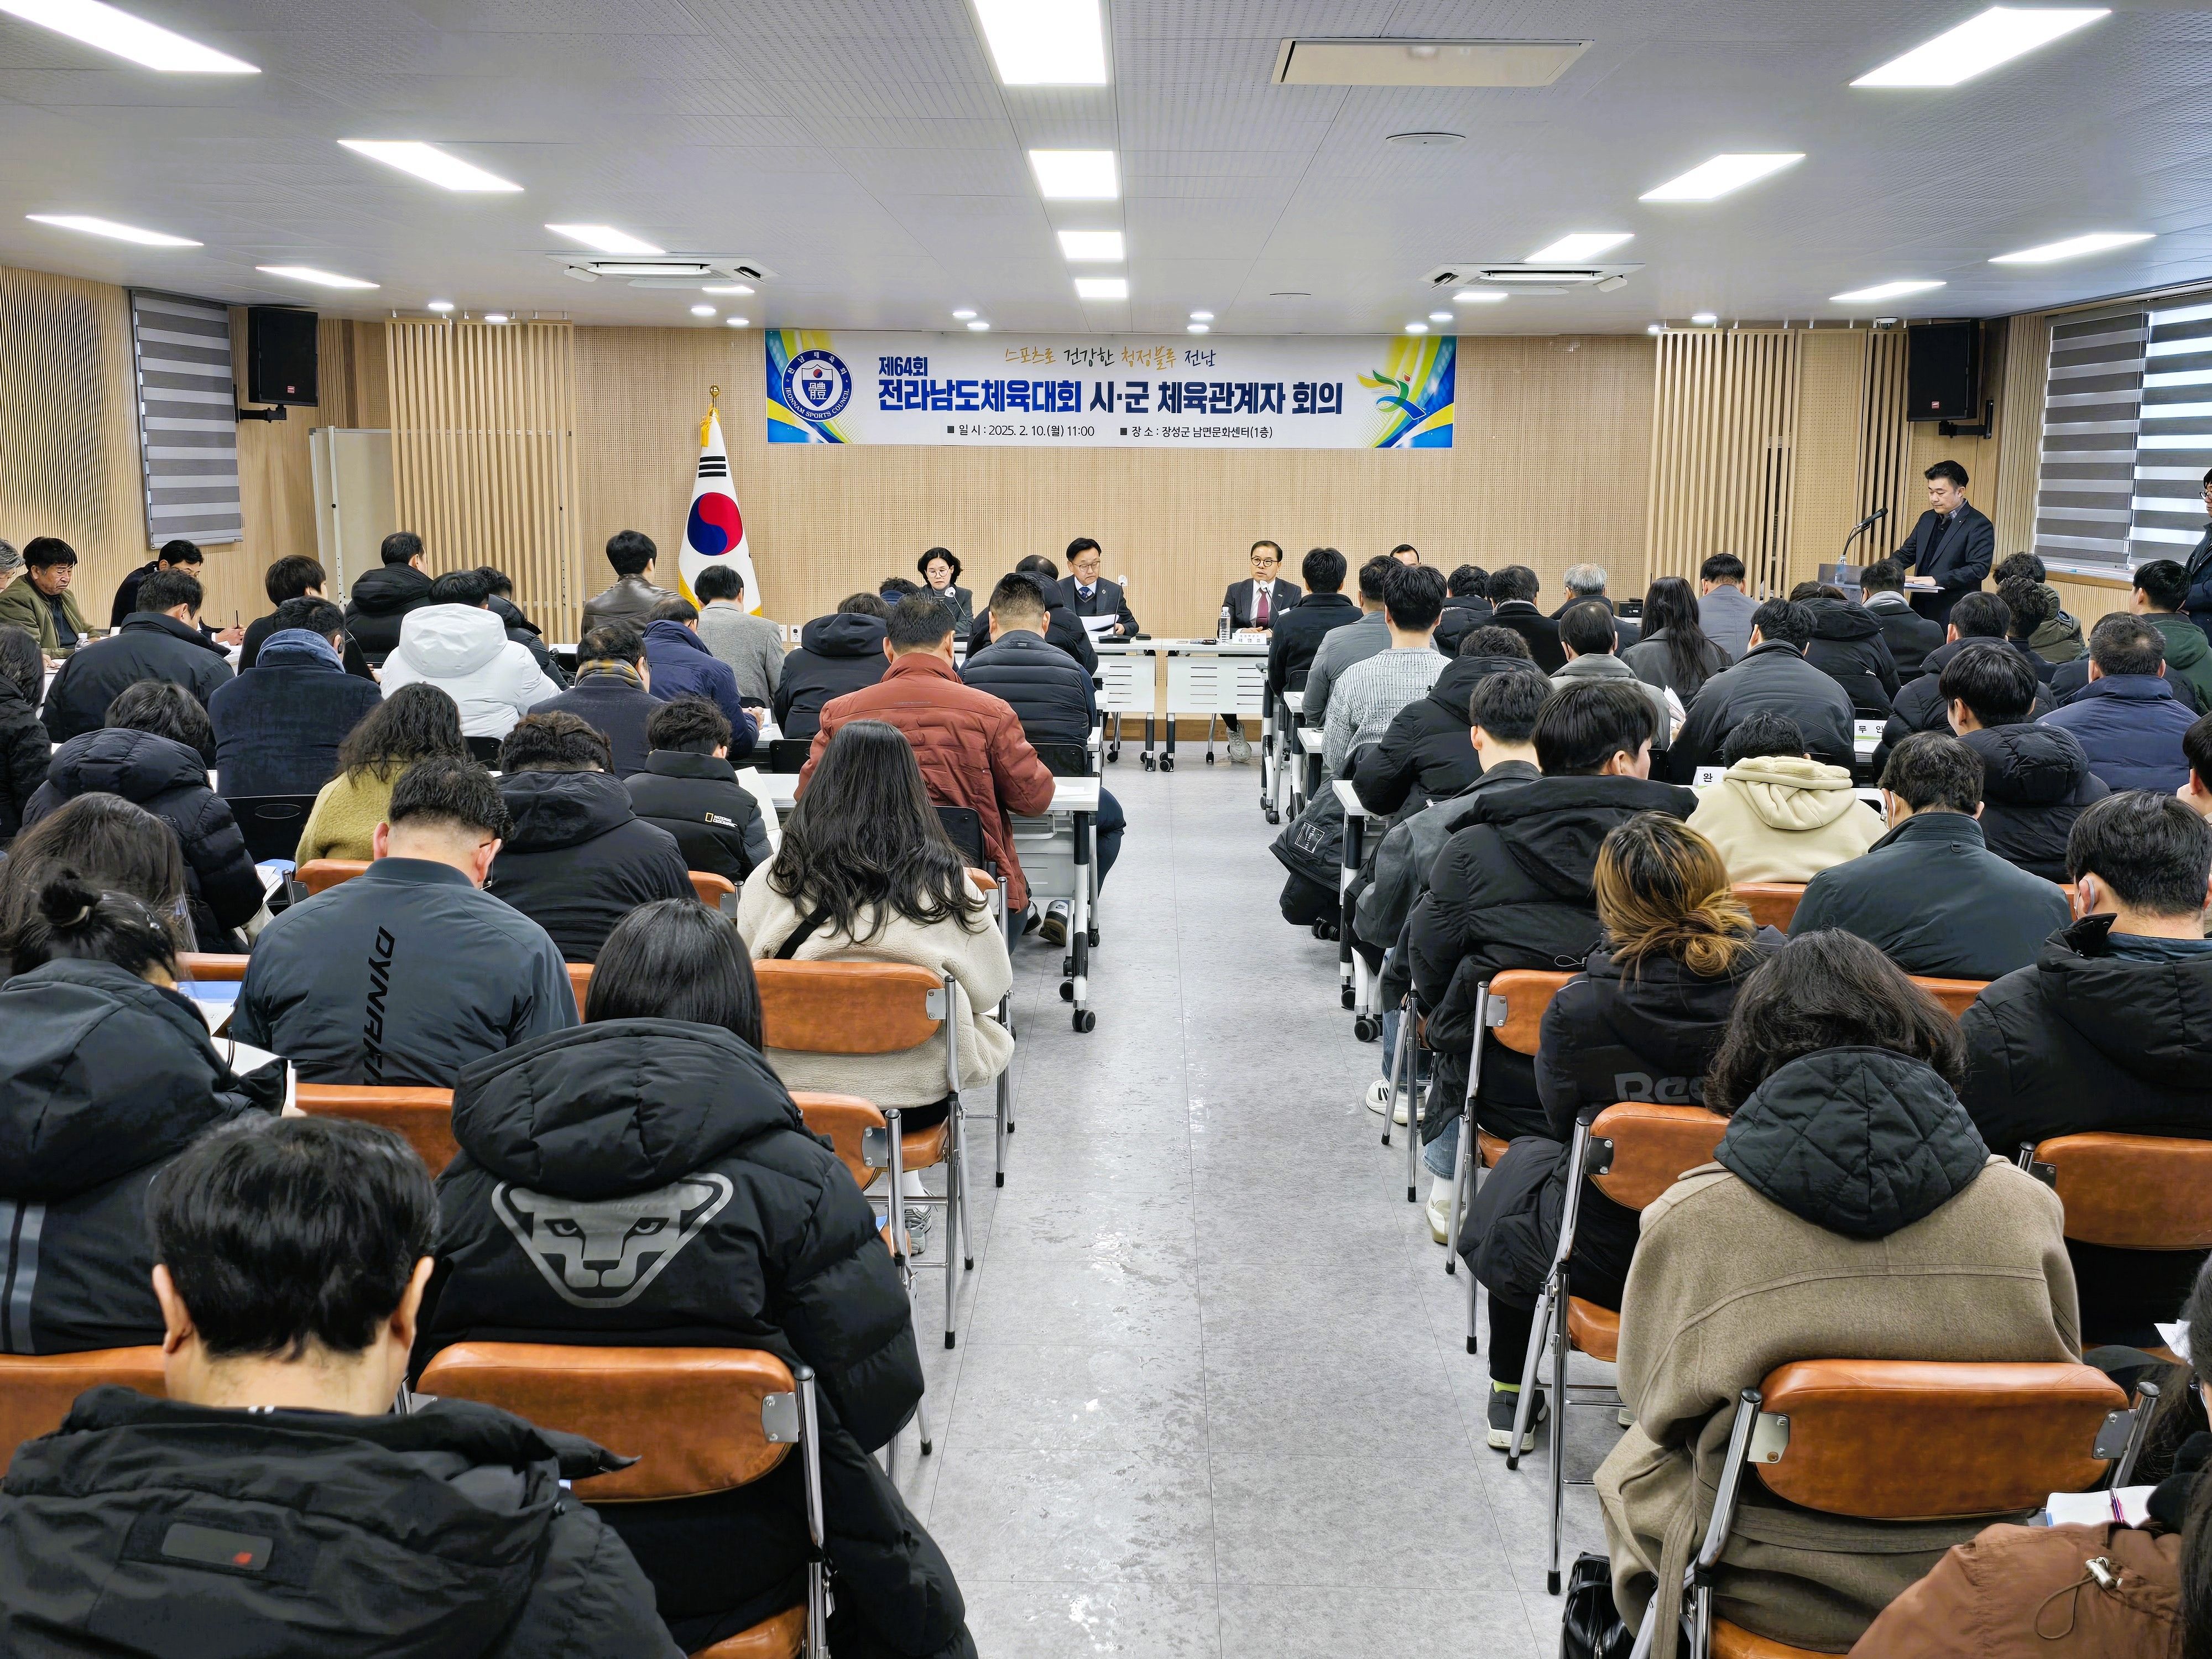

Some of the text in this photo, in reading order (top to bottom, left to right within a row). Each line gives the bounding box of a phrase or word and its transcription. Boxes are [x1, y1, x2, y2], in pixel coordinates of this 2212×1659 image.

[878, 356, 928, 377] 제64회
[1005, 345, 1217, 371] 스포츠로 건강한 청정블루 전남
[785, 387, 849, 419] JEONNAM SPORTS COUNCIL
[878, 379, 1343, 414] 전라남도체육대회 시·군 체육관계자 회의
[989, 425, 1016, 436] 2025.
[1019, 425, 1028, 436] 2.
[1067, 426, 1095, 436] 11:00
[1162, 426, 1190, 438] 장성군
[1193, 426, 1273, 439] 남면문화센터(1층)
[1703, 773, 1713, 782] 완
[363, 925, 395, 1085] DYNAFI
